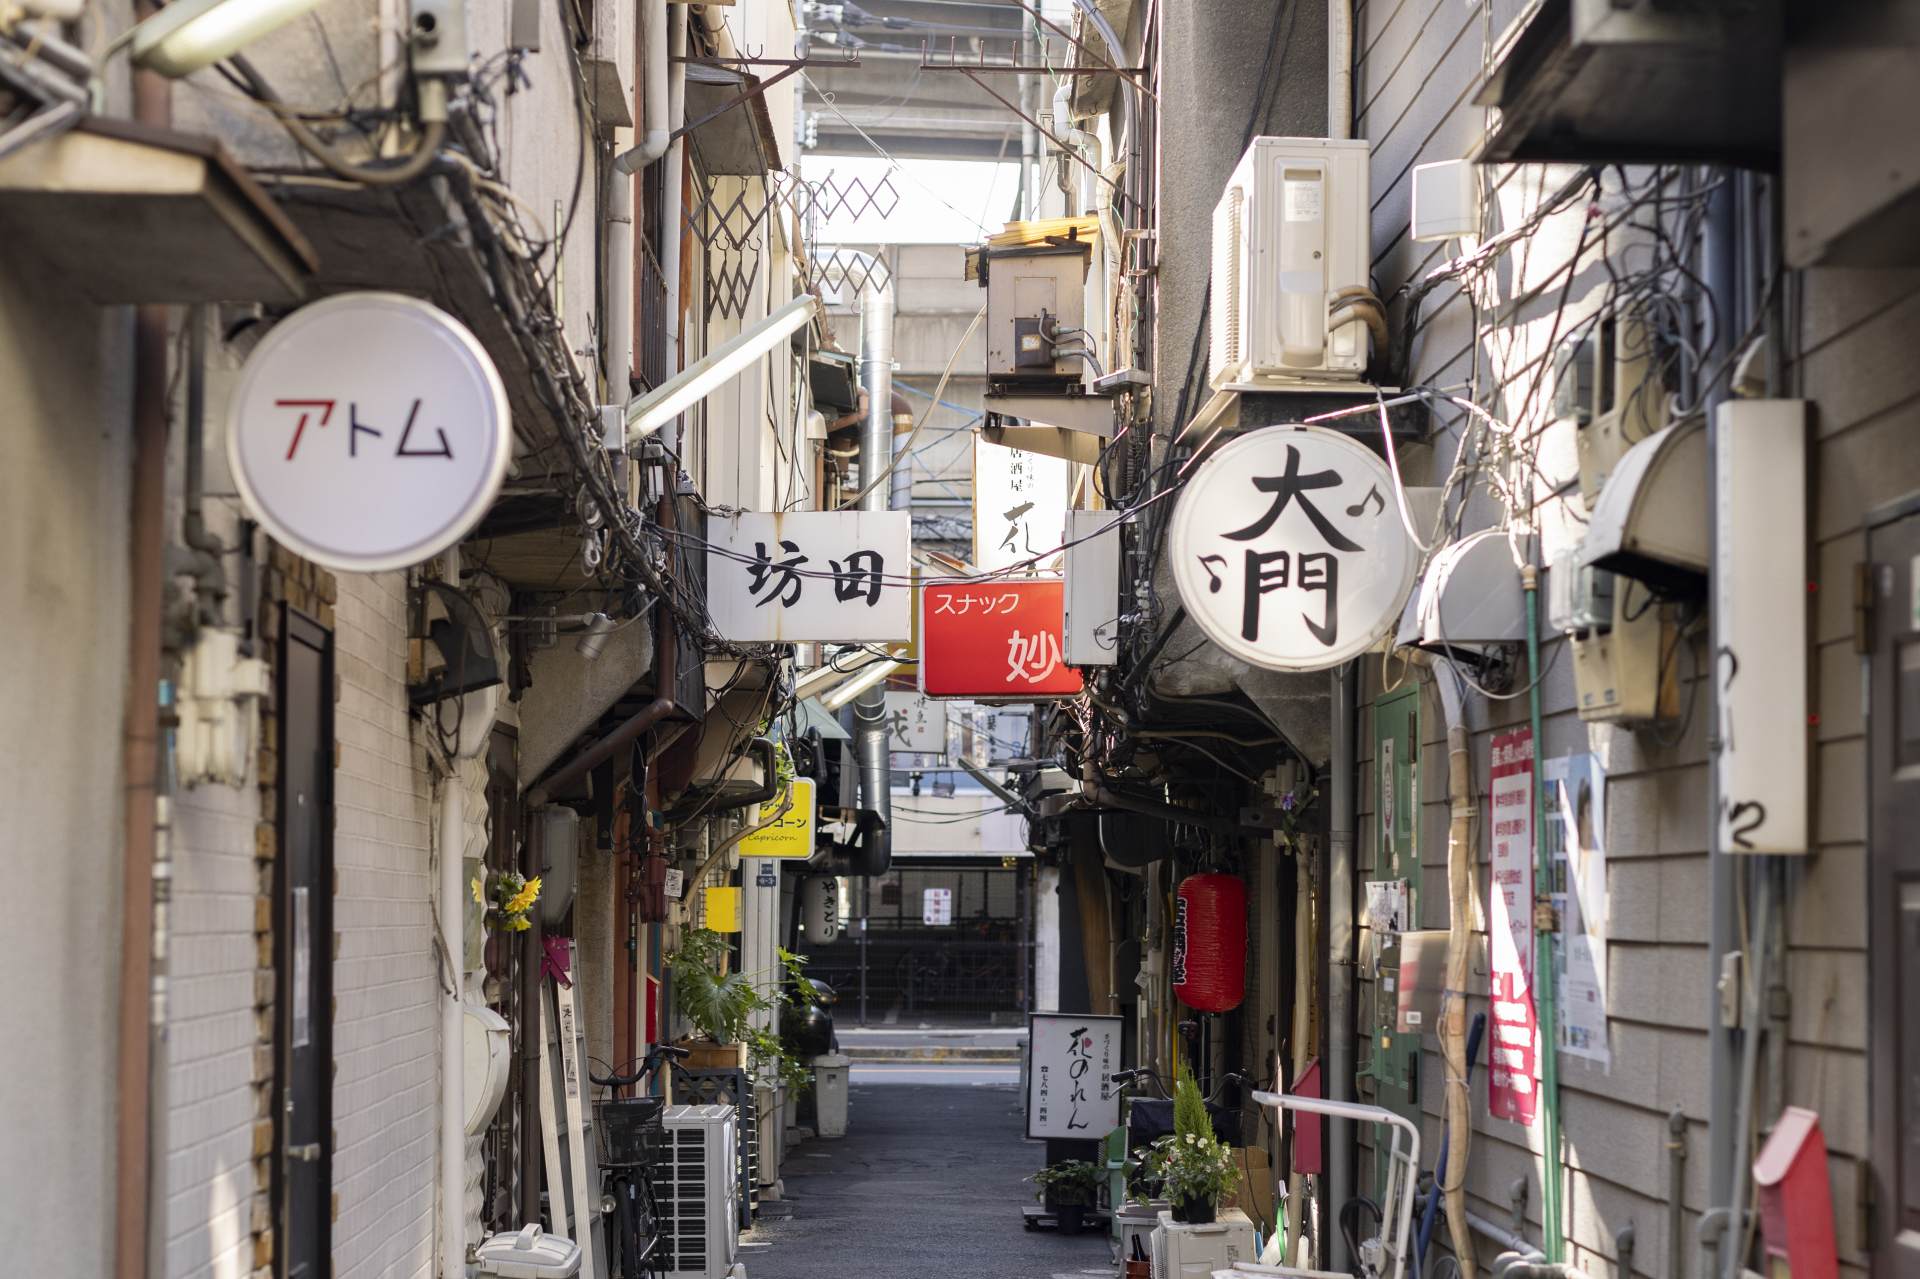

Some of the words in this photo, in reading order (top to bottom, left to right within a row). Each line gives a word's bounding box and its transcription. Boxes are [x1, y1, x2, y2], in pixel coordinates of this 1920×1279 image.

[275, 398, 454, 460] アトム
[746, 540, 884, 608] 坊田
[1219, 444, 1366, 647] 大門
[934, 593, 1020, 615] スナック
[1006, 629, 1062, 684] 妙
[821, 880, 836, 938] やきとり
[1066, 1026, 1094, 1130] 花のれん
[1100, 1073, 1110, 1101] 居酒屋
